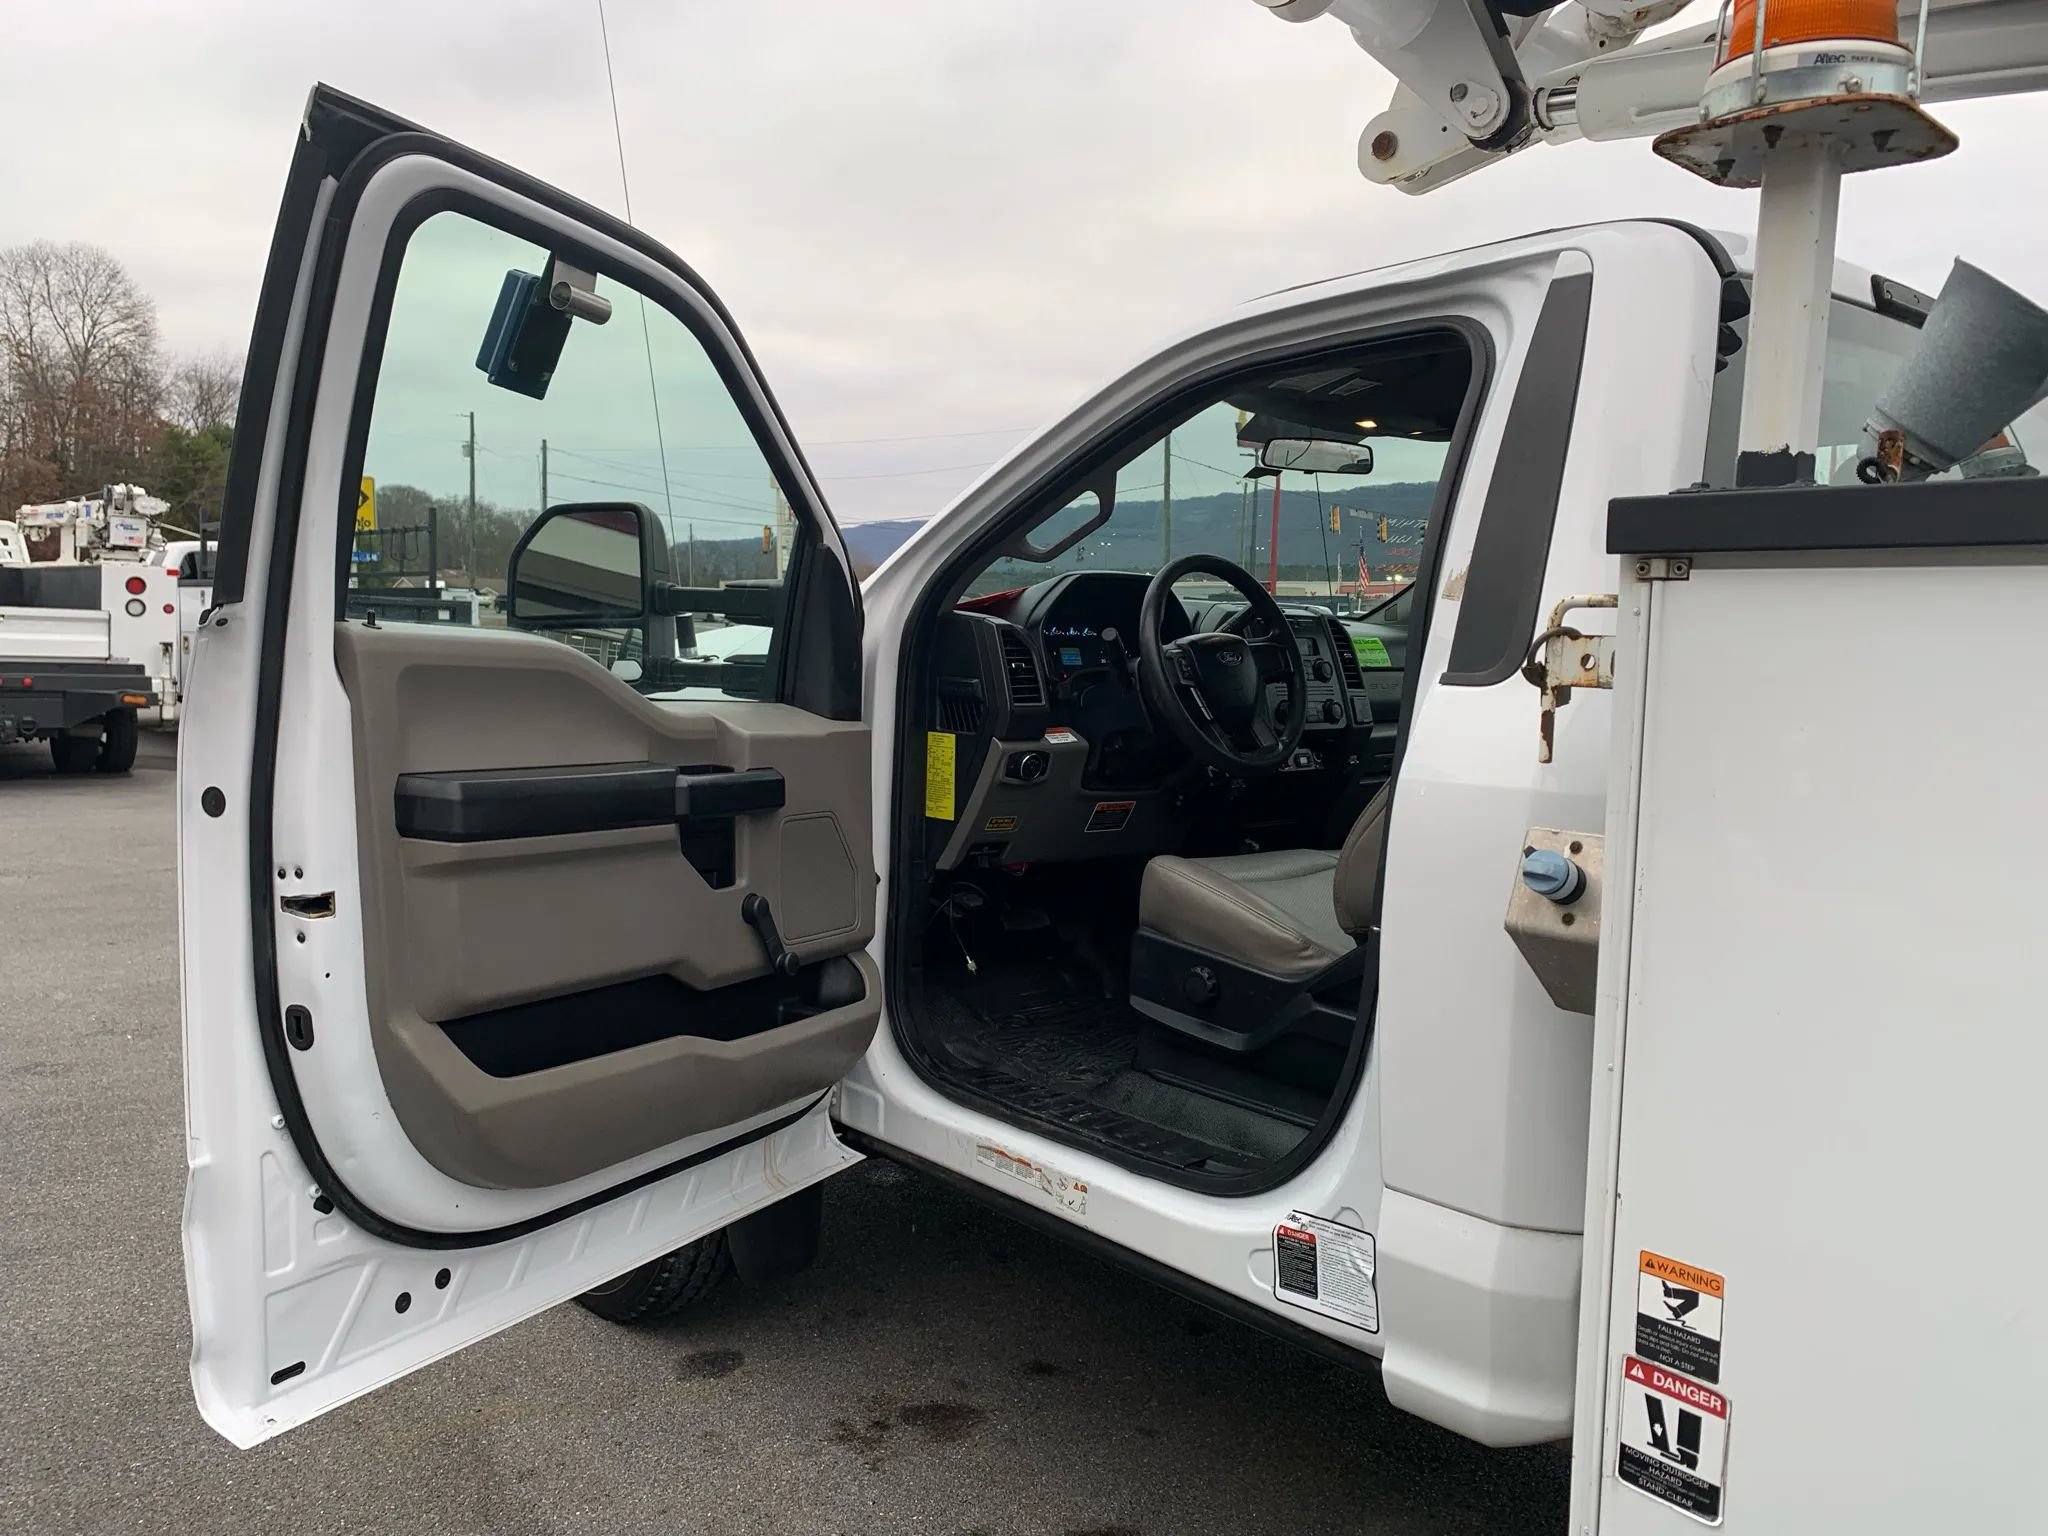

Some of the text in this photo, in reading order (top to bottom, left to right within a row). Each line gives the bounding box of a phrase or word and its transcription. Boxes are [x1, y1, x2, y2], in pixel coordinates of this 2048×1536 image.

[1814, 52, 1846, 65] Altec
[1287, 1229, 1310, 1241] DANGER
[1657, 1262, 1720, 1291] WARNING
[1658, 1324, 1701, 1345] FALL HAZARD
[1660, 1353, 1673, 1363] NOT
[1681, 1362, 1696, 1371] STEP
[1653, 1371, 1722, 1411] DANGER
[1625, 1447, 1660, 1467] MOVING
[1661, 1463, 1709, 1490] OUTRIGGER
[1649, 1466, 1682, 1487] HAZARD
[1638, 1477, 1665, 1495] STAND
[1666, 1489, 1693, 1507] CLEAR
